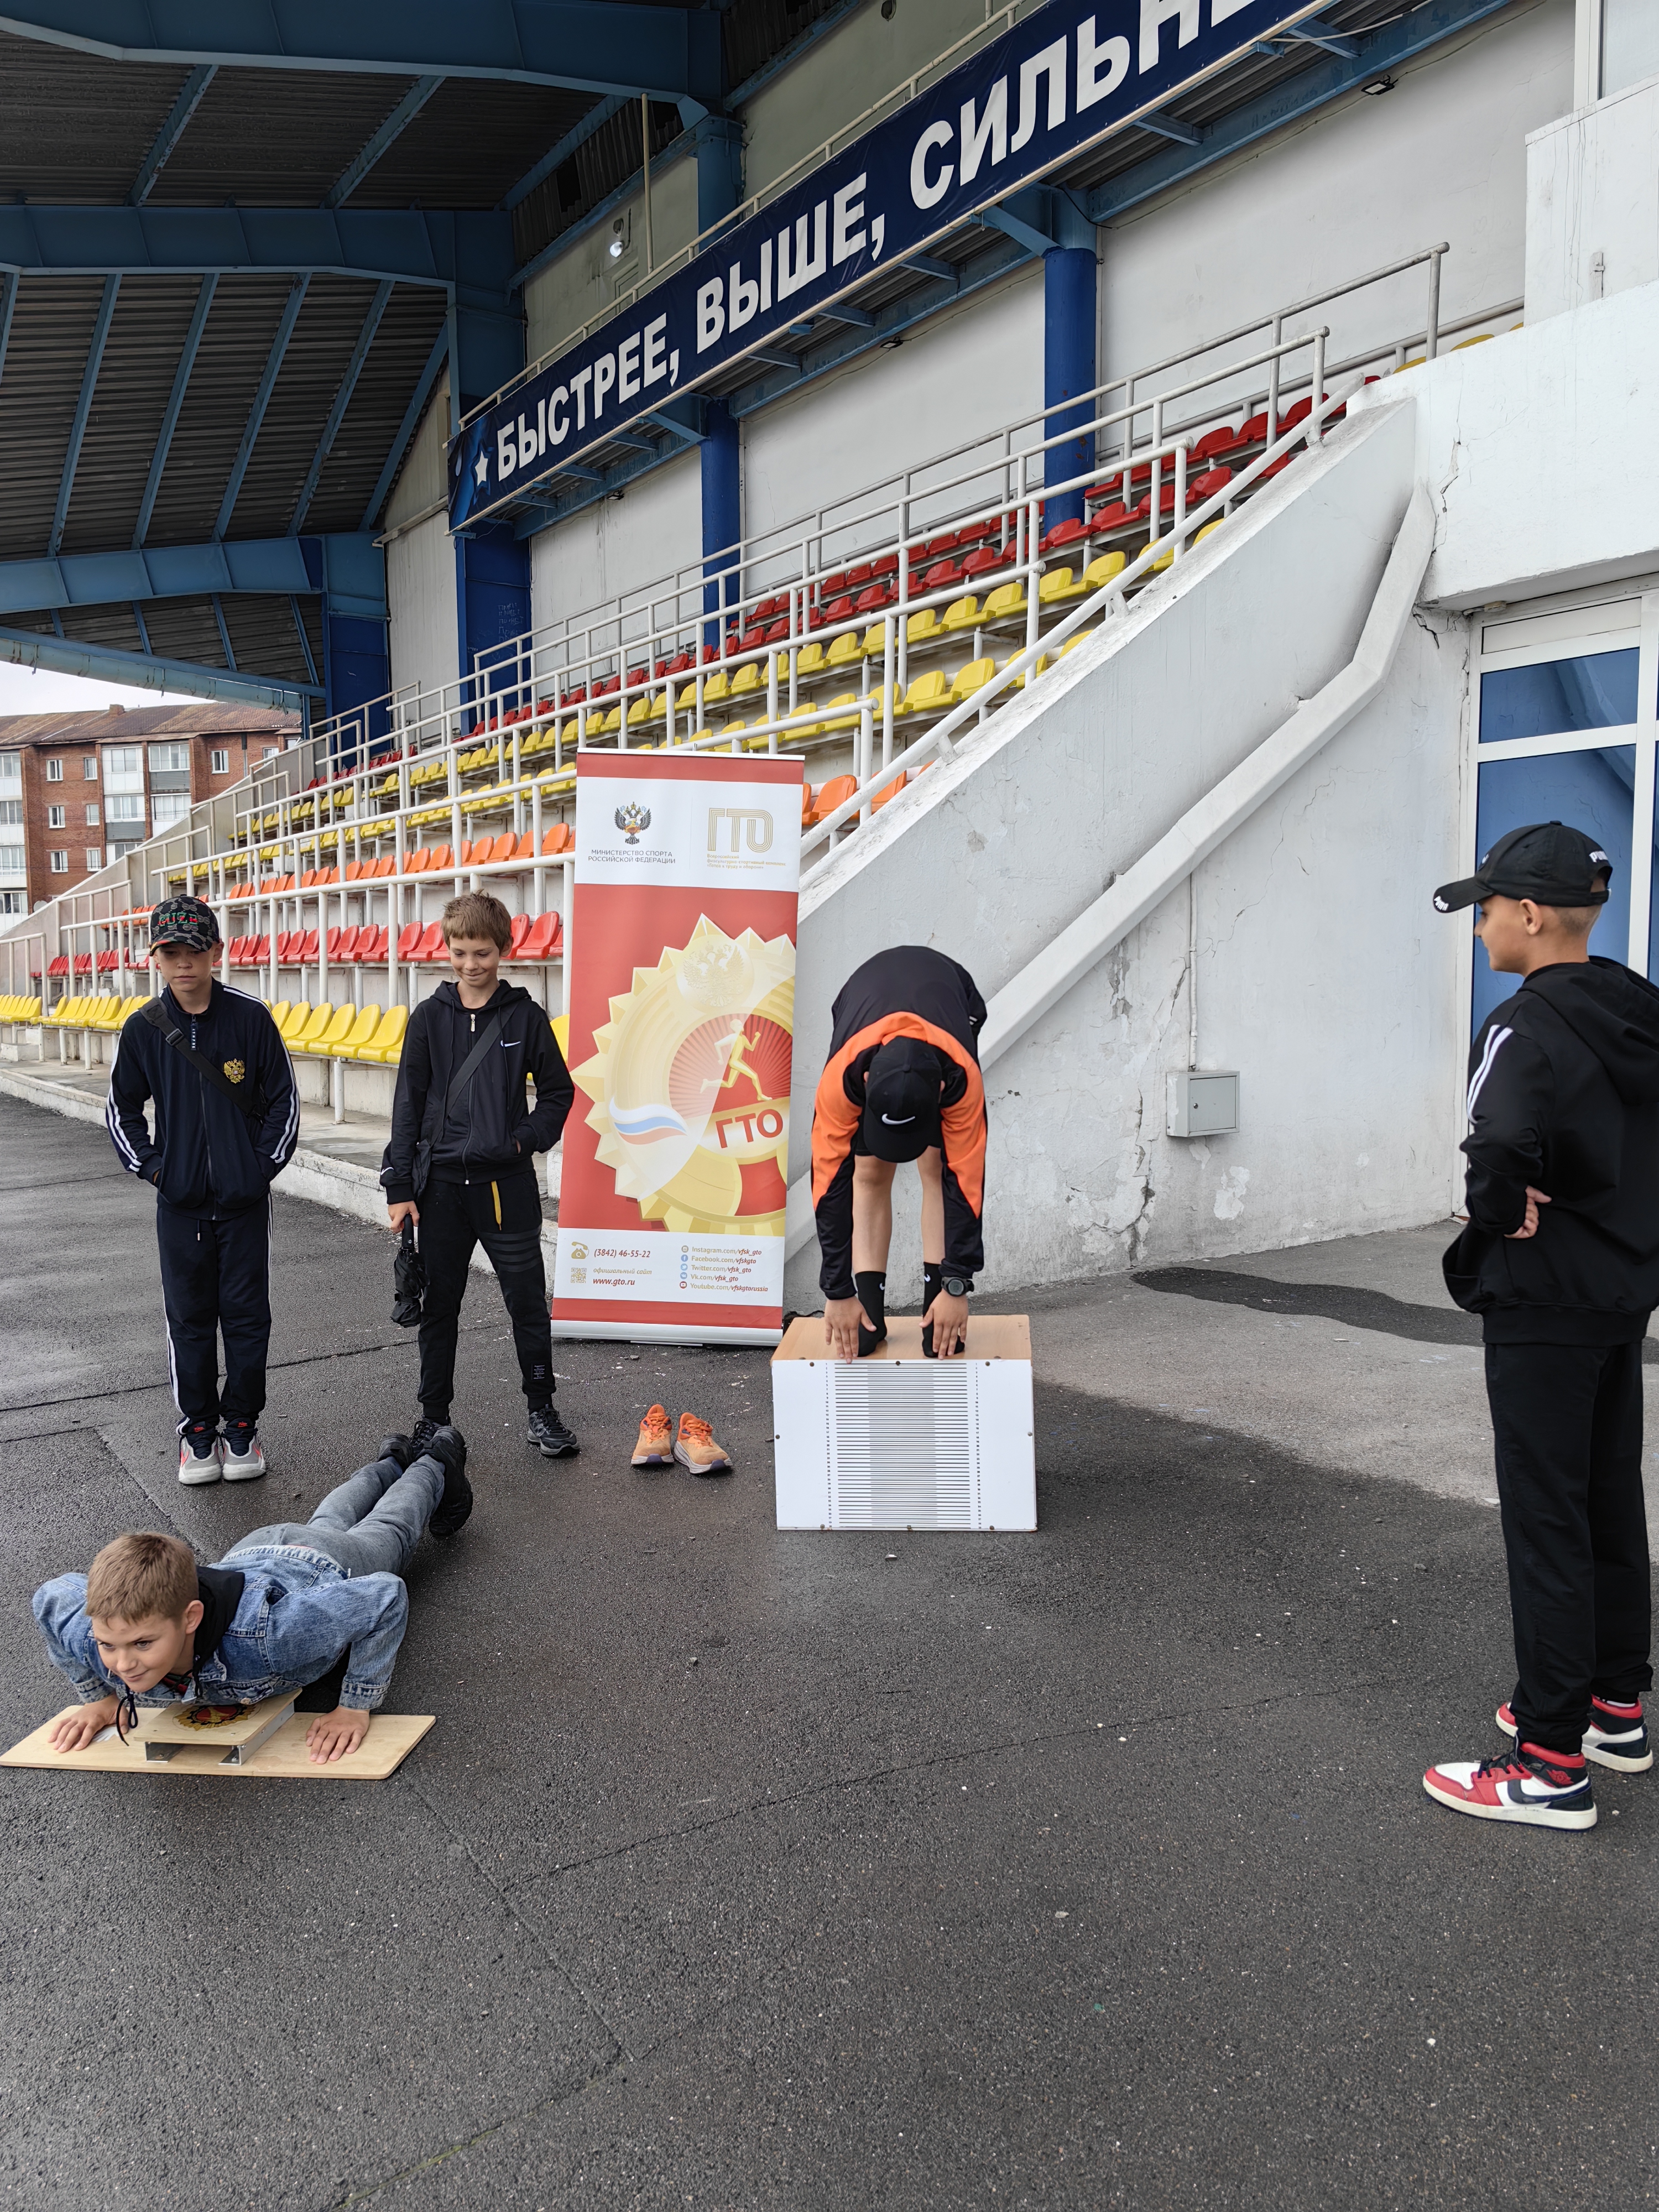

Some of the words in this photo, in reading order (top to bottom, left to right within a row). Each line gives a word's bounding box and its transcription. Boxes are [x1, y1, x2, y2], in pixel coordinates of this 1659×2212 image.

[498, 312, 679, 482] БЫСТРЕЕ,
[697, 171, 885, 354] ВЫШЕ,
[910, 0, 1255, 210] СИЛЬН
[707, 807, 774, 853] ГТО
[716, 1109, 784, 1149] ГТО
[594, 1249, 617, 1259] (3842)
[691, 1255, 757, 1265] Facebook.com/vfskgto
[691, 1265, 752, 1274] Twitter.com/vfsk_gto
[592, 1279, 635, 1287] www.gto.ru
